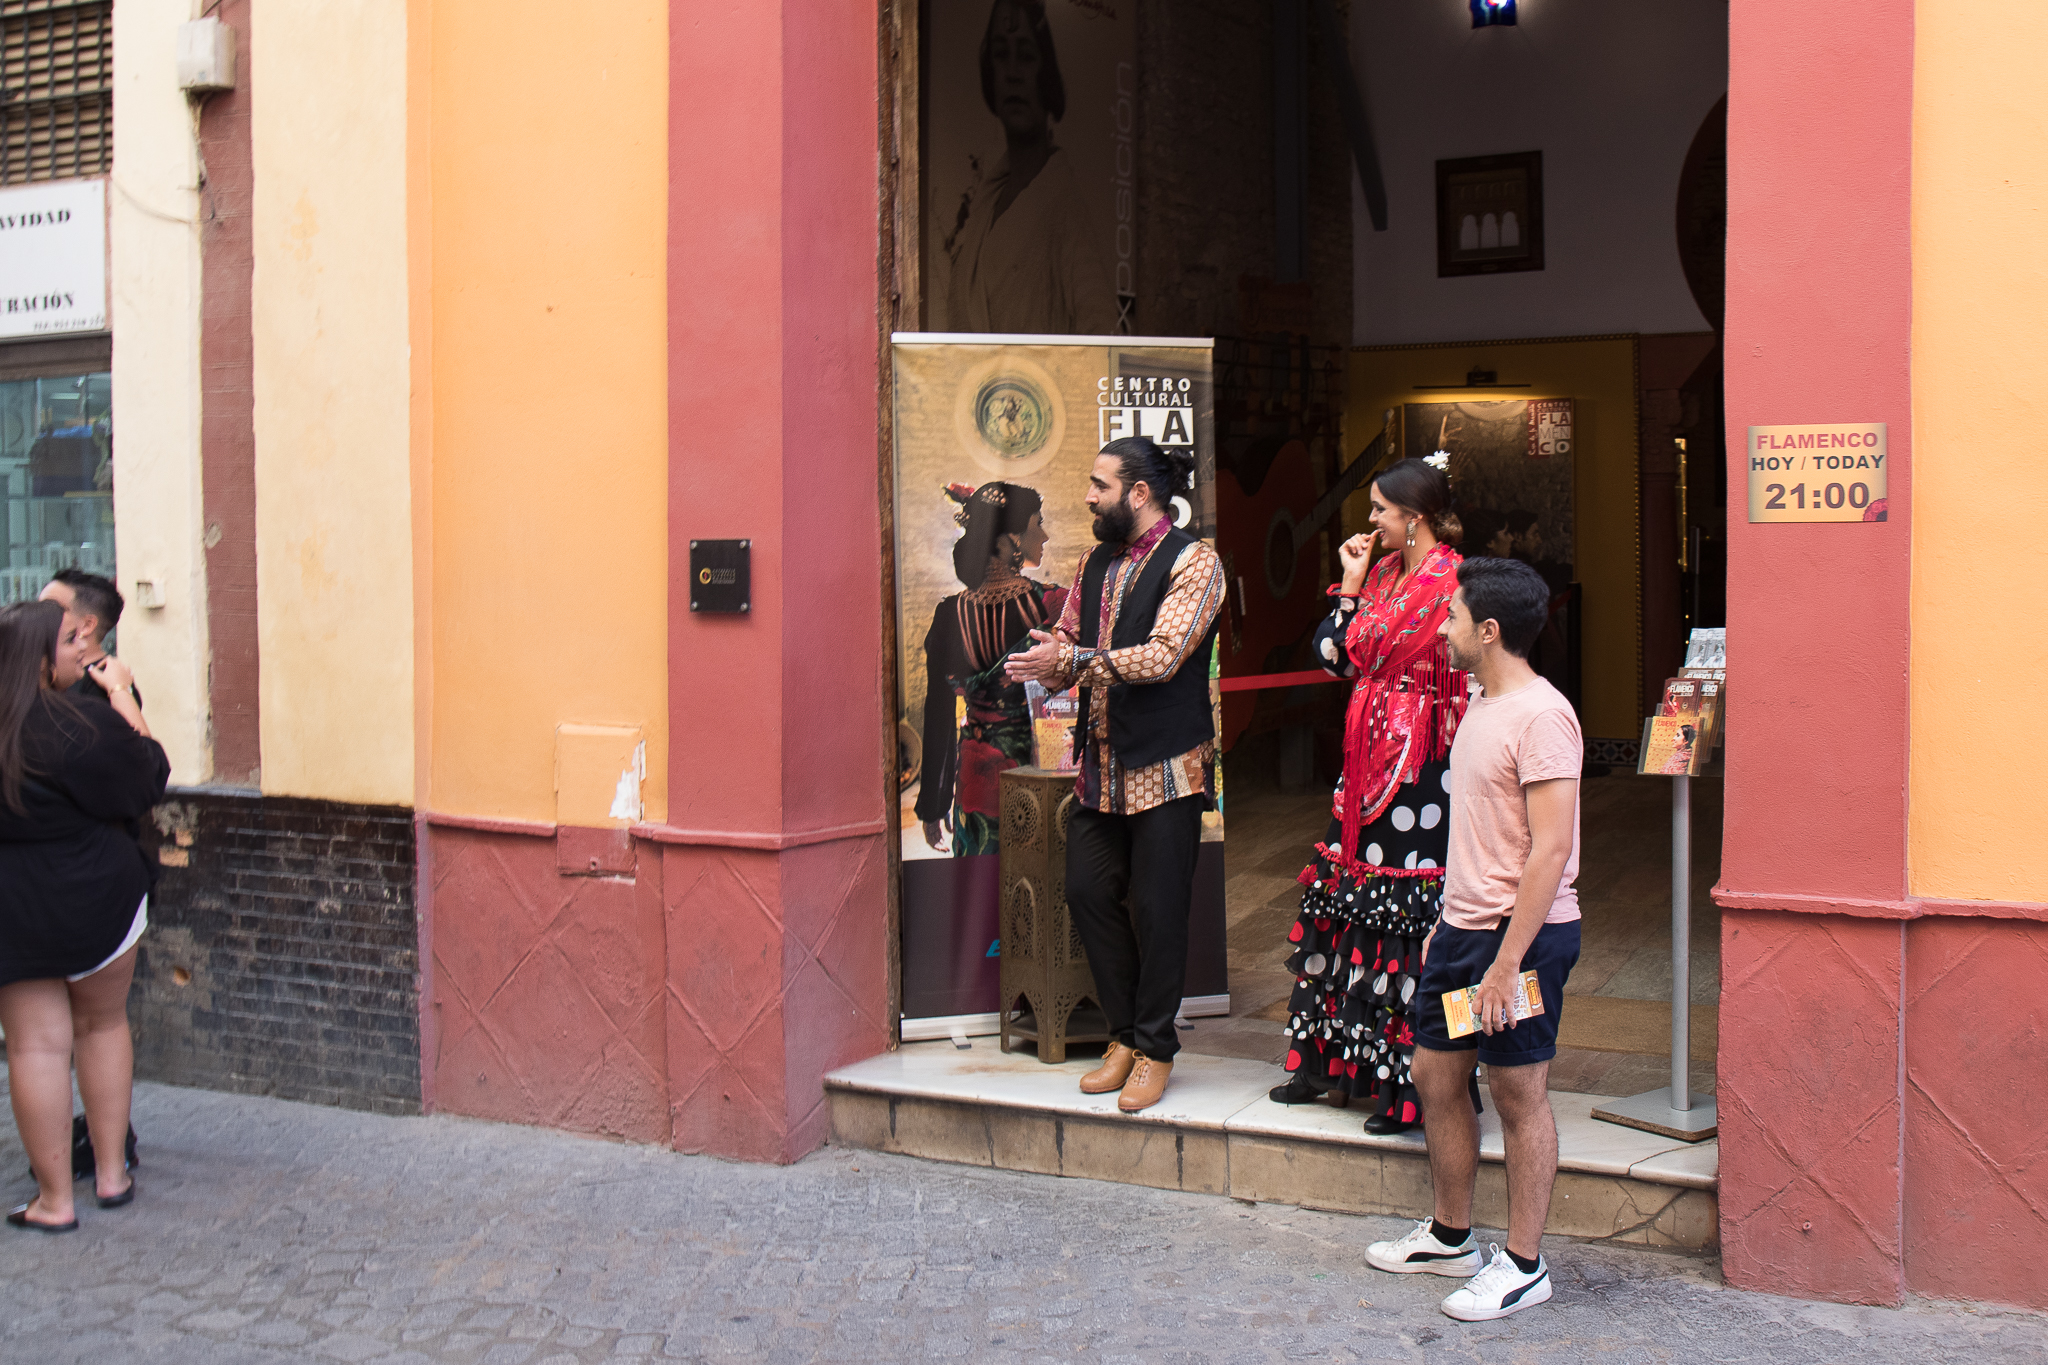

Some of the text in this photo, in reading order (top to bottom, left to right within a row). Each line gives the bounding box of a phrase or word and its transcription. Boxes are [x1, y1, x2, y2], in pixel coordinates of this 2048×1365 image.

[1111, 62, 1136, 333] xposición
[1097, 376, 1191, 392] CENTRO
[1096, 391, 1192, 407] CULTURAL
[1102, 409, 1190, 443] FLA
[1540, 412, 1569, 425] FLA
[1540, 441, 1570, 454] CO
[1756, 432, 1878, 449] FLAMENCO
[1751, 456, 1795, 471] HOY
[1813, 454, 1885, 469] TODAY
[1765, 482, 1870, 509] 21:00
